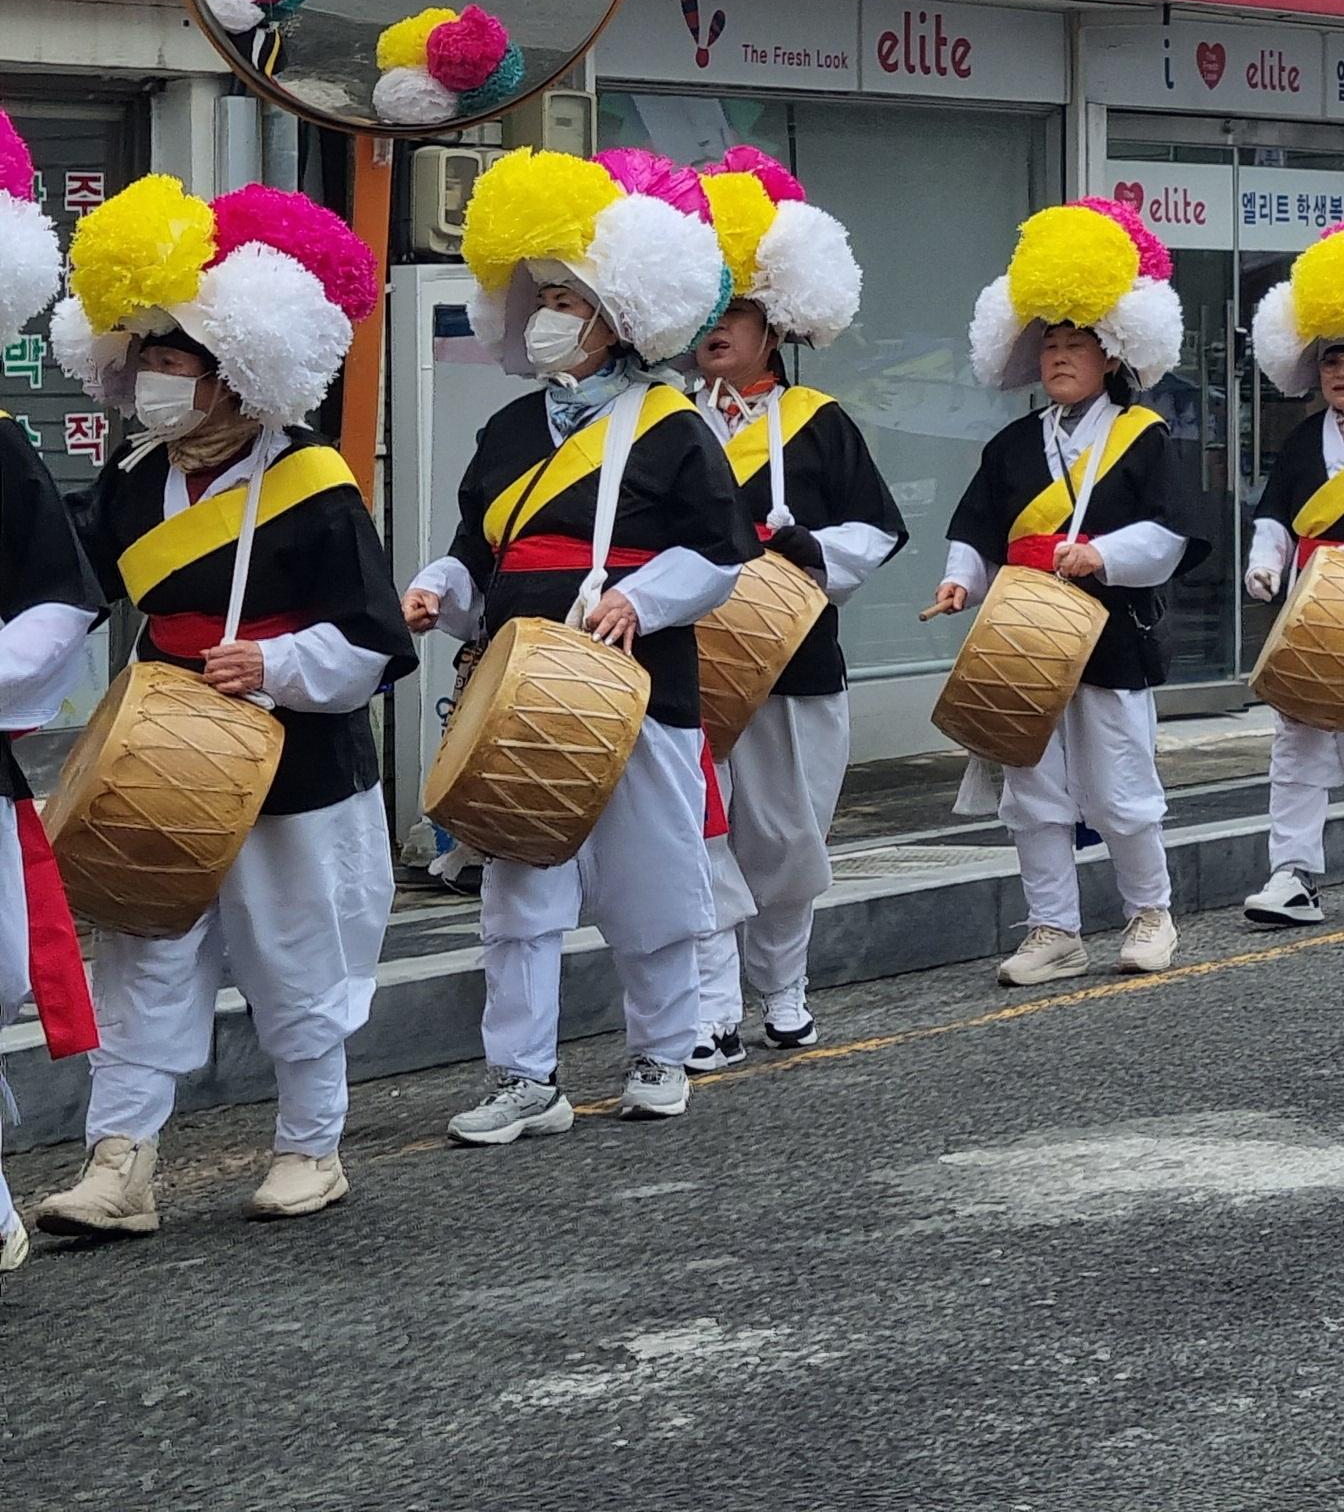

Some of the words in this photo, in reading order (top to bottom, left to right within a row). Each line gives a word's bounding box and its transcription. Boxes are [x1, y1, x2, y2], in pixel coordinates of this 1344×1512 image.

[742, 44, 769, 67] The
[773, 45, 811, 69] Fresh
[815, 48, 849, 71] Look
[877, 10, 973, 80] elite
[1246, 49, 1301, 94] elite
[1149, 186, 1207, 225] elite
[1241, 191, 1291, 226] 엘리트
[1296, 192, 1344, 229] 학생복
